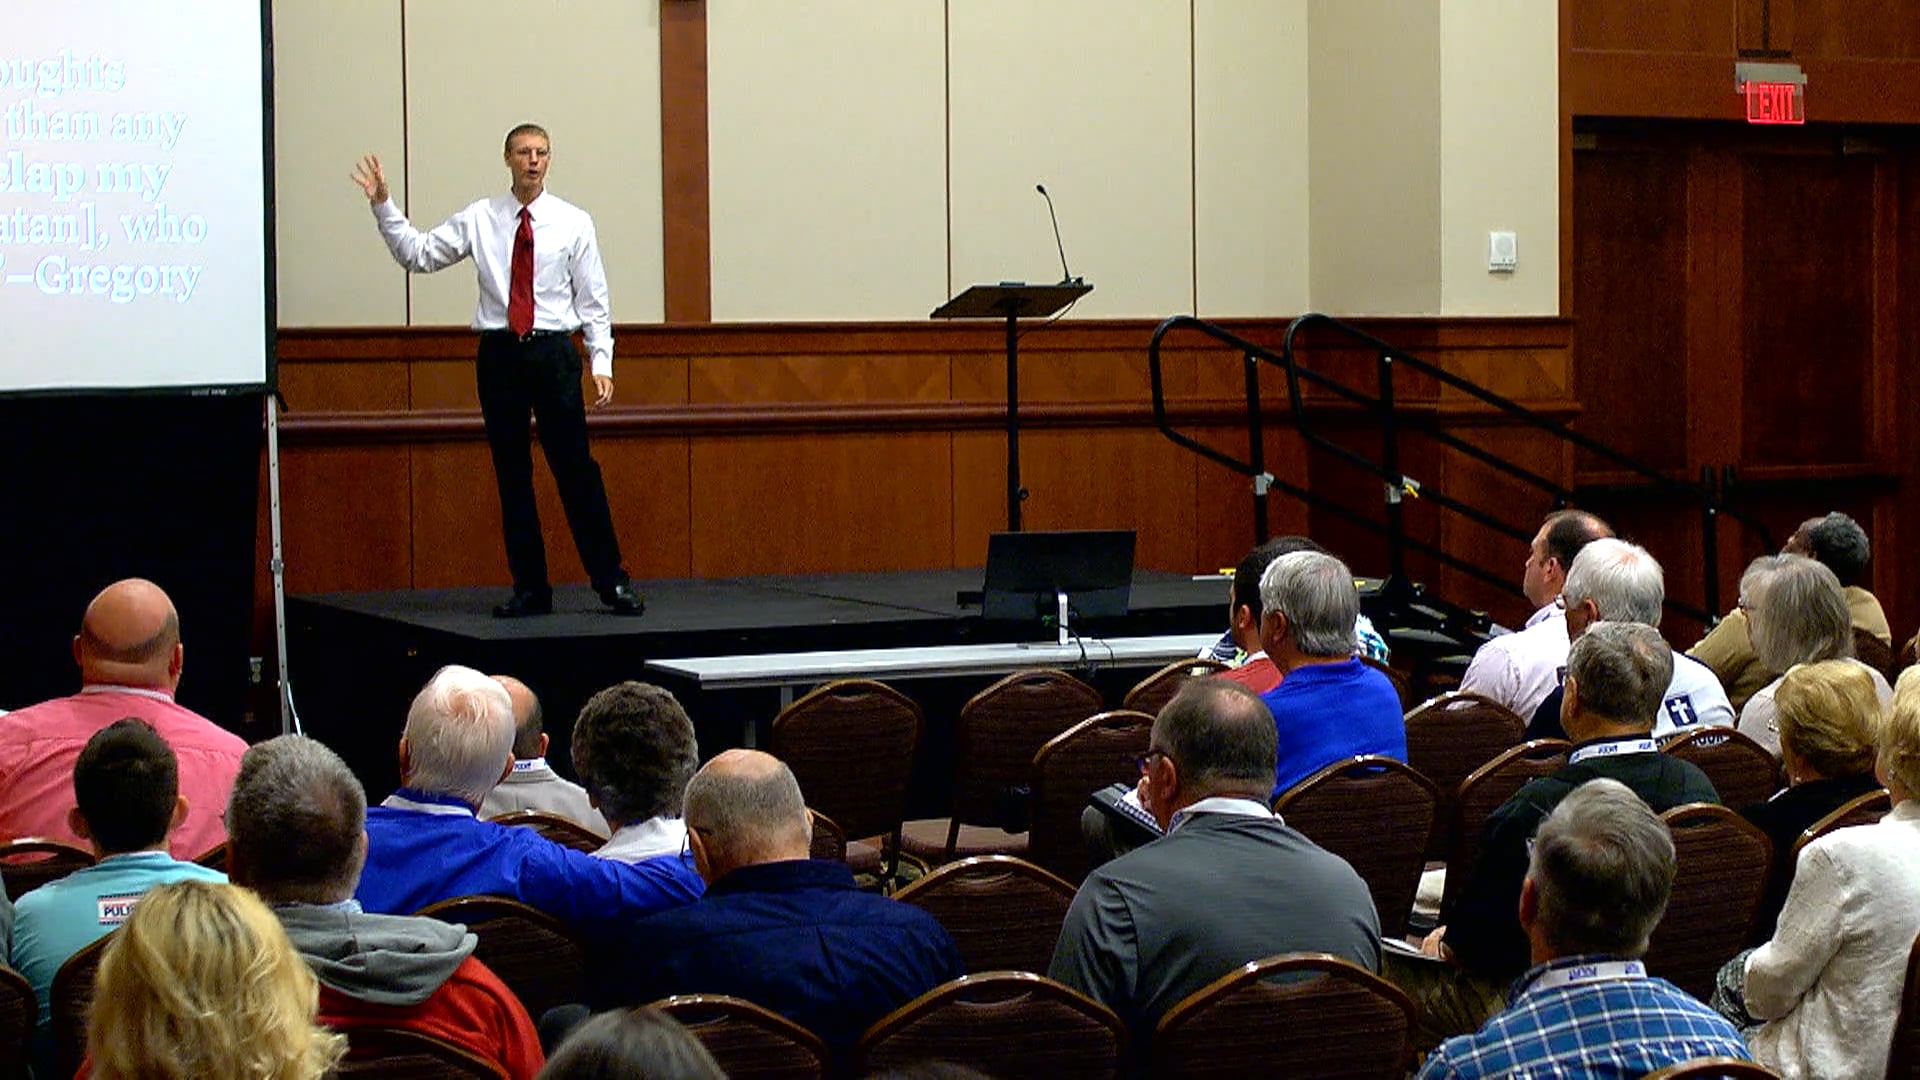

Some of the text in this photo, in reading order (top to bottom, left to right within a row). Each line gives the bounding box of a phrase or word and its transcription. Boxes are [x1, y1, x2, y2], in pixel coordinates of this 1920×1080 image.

[1759, 84, 1795, 120] EXIT
[6, 98, 188, 151] than any
[96, 159, 174, 202] my
[120, 202, 208, 244] who
